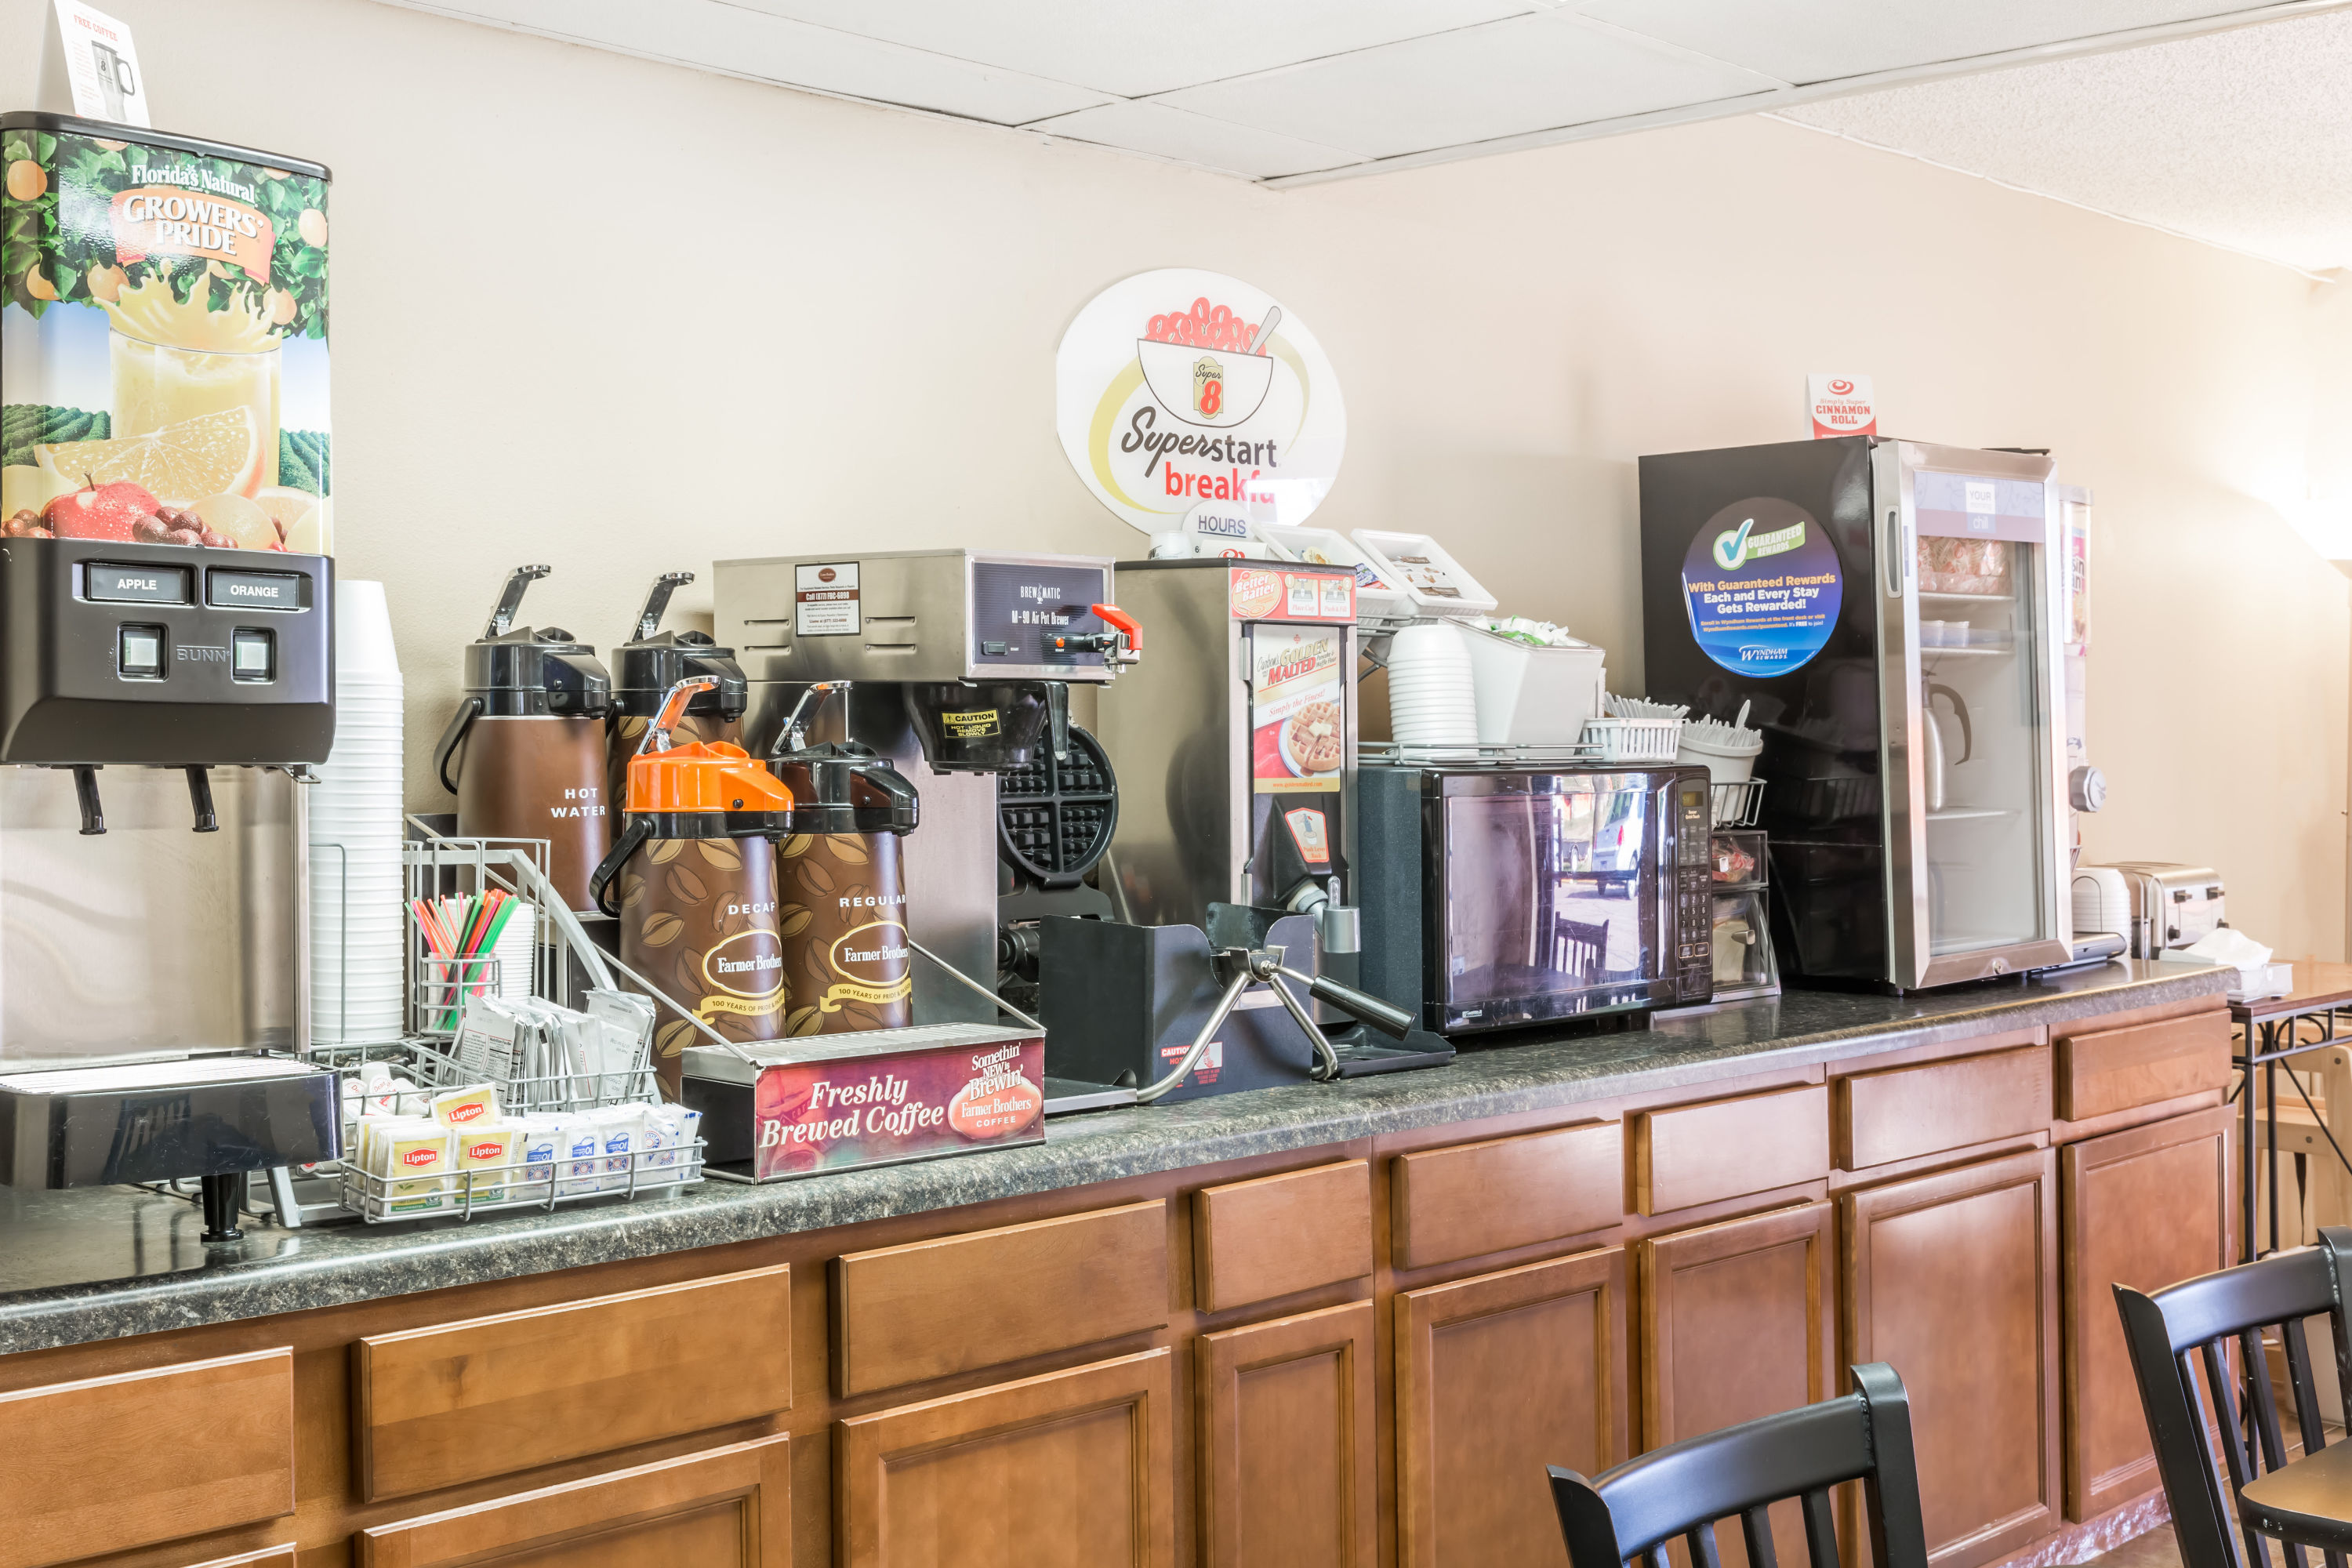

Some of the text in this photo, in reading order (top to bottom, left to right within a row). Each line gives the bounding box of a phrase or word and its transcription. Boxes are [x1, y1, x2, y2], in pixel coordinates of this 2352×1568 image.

[73, 14, 118, 42] FREE COFFEE
[201, 169, 255, 204] Natural
[122, 195, 263, 238] GROWERS'
[156, 220, 237, 256] PRIDE
[1196, 364, 1222, 385] Super
[1200, 379, 1221, 415] 8
[1816, 405, 1871, 415] CINNAMON
[1831, 415, 1858, 424] ROLL
[1121, 406, 1277, 478] Superstart
[1969, 490, 1992, 501] YOUR
[1198, 514, 1247, 534] HOURS
[1973, 516, 1989, 529] chill
[1748, 524, 1802, 549] GUARANTEED
[1757, 540, 1789, 557] REWARDS
[117, 578, 157, 590] APPLE
[1235, 573, 1269, 593] Better
[1688, 572, 1836, 593] With Guaranteed Rewards
[230, 585, 279, 597] ORANGE
[805, 593, 815, 601] Call
[815, 592, 827, 601] (877)
[1704, 587, 1820, 604] Each and Every Stay
[1717, 599, 1806, 615] Gets Rewarded!
[1040, 611, 1050, 625] Pot
[1051, 612, 1069, 626] Brewer
[176, 648, 227, 662] BUNN
[1279, 638, 1329, 666] GOLDEN
[1267, 656, 1316, 686] MALTED
[1269, 688, 1326, 717] Simply the Finest!
[955, 713, 994, 722] CAUTION
[564, 787, 598, 800] HOT
[550, 805, 606, 818] WATER
[728, 902, 775, 915] DECAF
[839, 894, 906, 908] REGULAR
[844, 944, 909, 963] Farmer Brothers
[717, 953, 782, 973] Farmer Brothers
[852, 989, 873, 1000] YEARS
[727, 1001, 747, 1011] YEARS
[971, 1041, 1022, 1071] Somethin'
[982, 1062, 1010, 1080] NEW is
[968, 1063, 1024, 1102] Brewin'
[808, 1074, 909, 1110] Freshly
[451, 1106, 482, 1120] Lipton
[961, 1096, 1032, 1119] Farmer Brothers
[758, 1102, 944, 1149] Brewed Coffee
[976, 1116, 1017, 1128] COFFEE
[471, 1147, 500, 1157] Lipton
[585, 1145, 593, 1155] 10
[619, 1142, 627, 1150] 10
[406, 1152, 435, 1163] Lipton
[541, 1152, 552, 1161] 10
